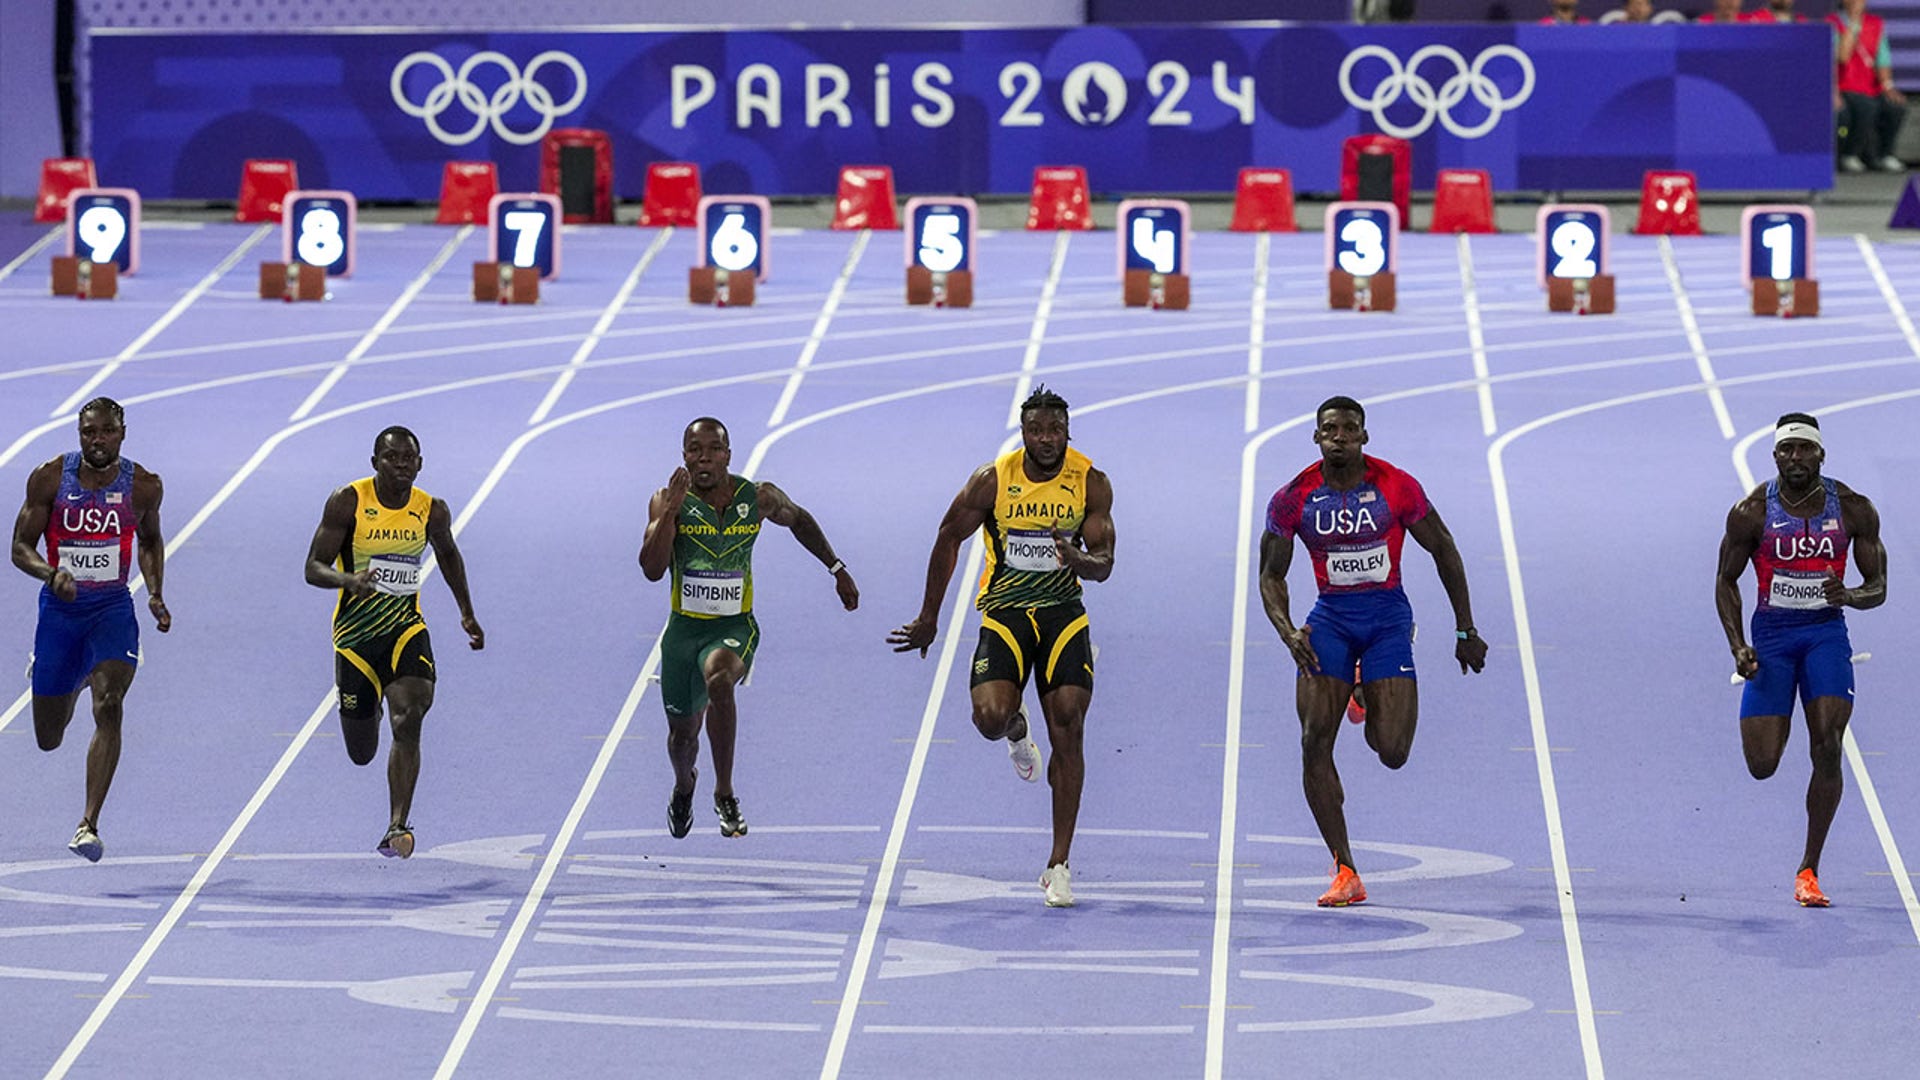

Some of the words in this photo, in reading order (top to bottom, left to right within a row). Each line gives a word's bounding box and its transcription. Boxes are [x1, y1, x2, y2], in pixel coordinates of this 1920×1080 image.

[79, 206, 125, 263] 9
[298, 208, 344, 266] 8
[504, 212, 546, 267] 7
[711, 214, 758, 271] 6
[919, 215, 963, 272] 5
[1133, 217, 1175, 273] 4
[1339, 219, 1385, 276] 3
[1552, 221, 1596, 278] 2
[1762, 223, 1792, 280] 1
[63, 508, 121, 535] USA
[365, 528, 418, 541] JAMAICA
[1005, 503, 1075, 520] JAMAICA
[1315, 507, 1377, 535] USA
[1331, 554, 1384, 573] KERLEY
[1775, 536, 1834, 560] USA
[683, 583, 741, 601] SIMBINE
